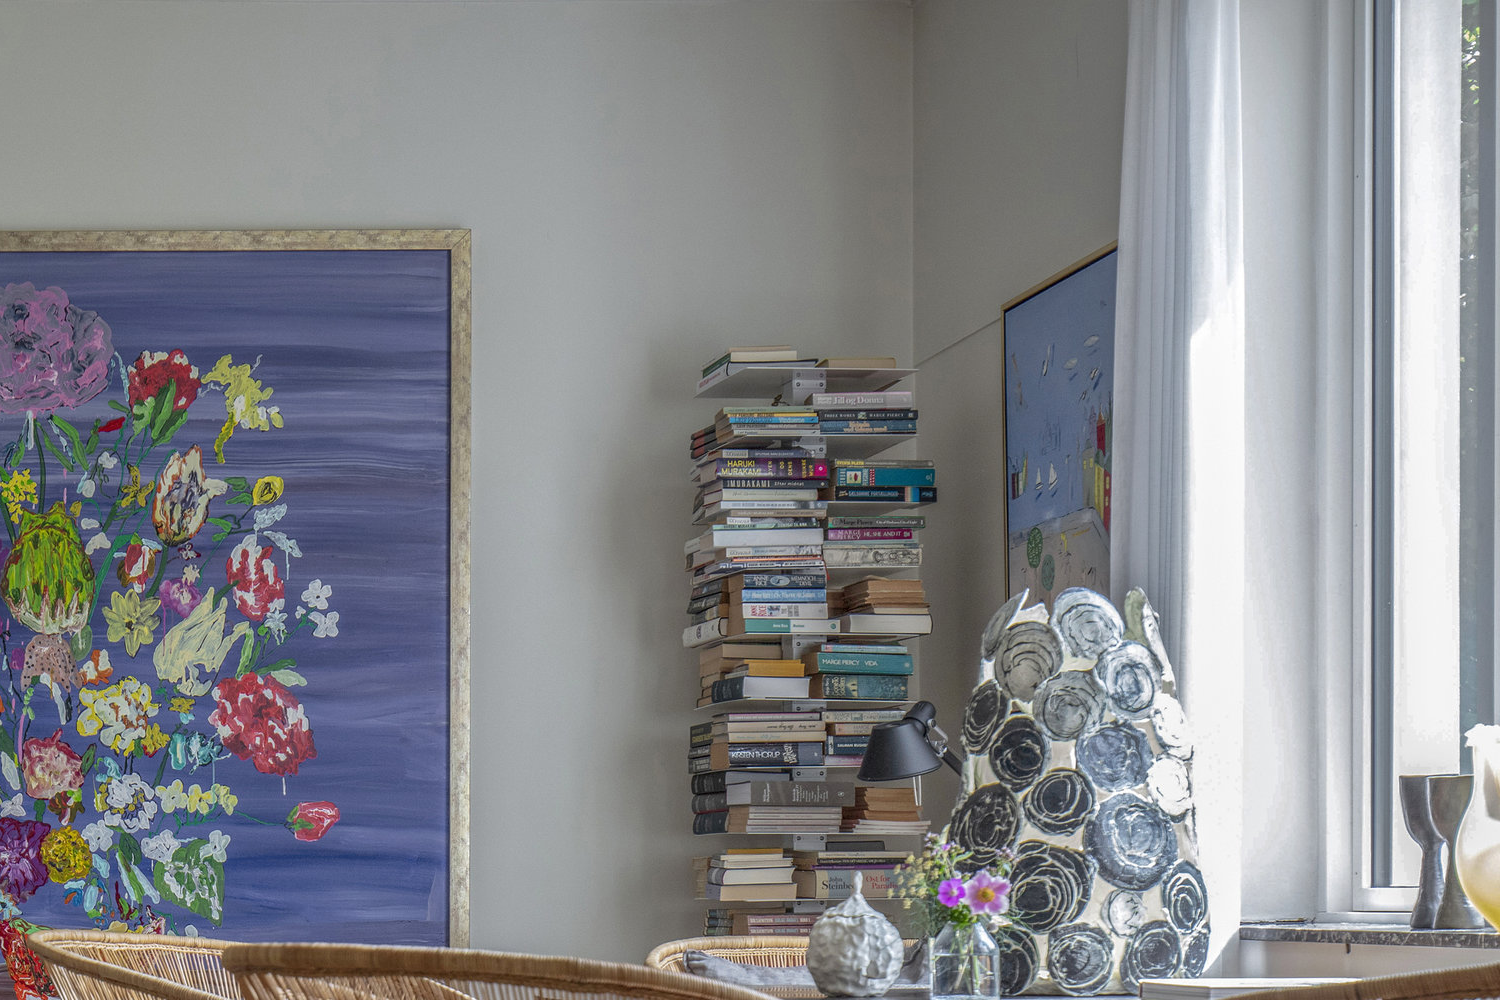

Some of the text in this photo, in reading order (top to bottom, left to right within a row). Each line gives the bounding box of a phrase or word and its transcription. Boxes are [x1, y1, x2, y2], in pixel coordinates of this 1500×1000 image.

[834, 396, 845, 405] Jill
[857, 396, 884, 404] Donna
[721, 468, 761, 476] MURAKAMI
[731, 480, 771, 488] MURAKAMI
[821, 879, 854, 890] Steinbe
